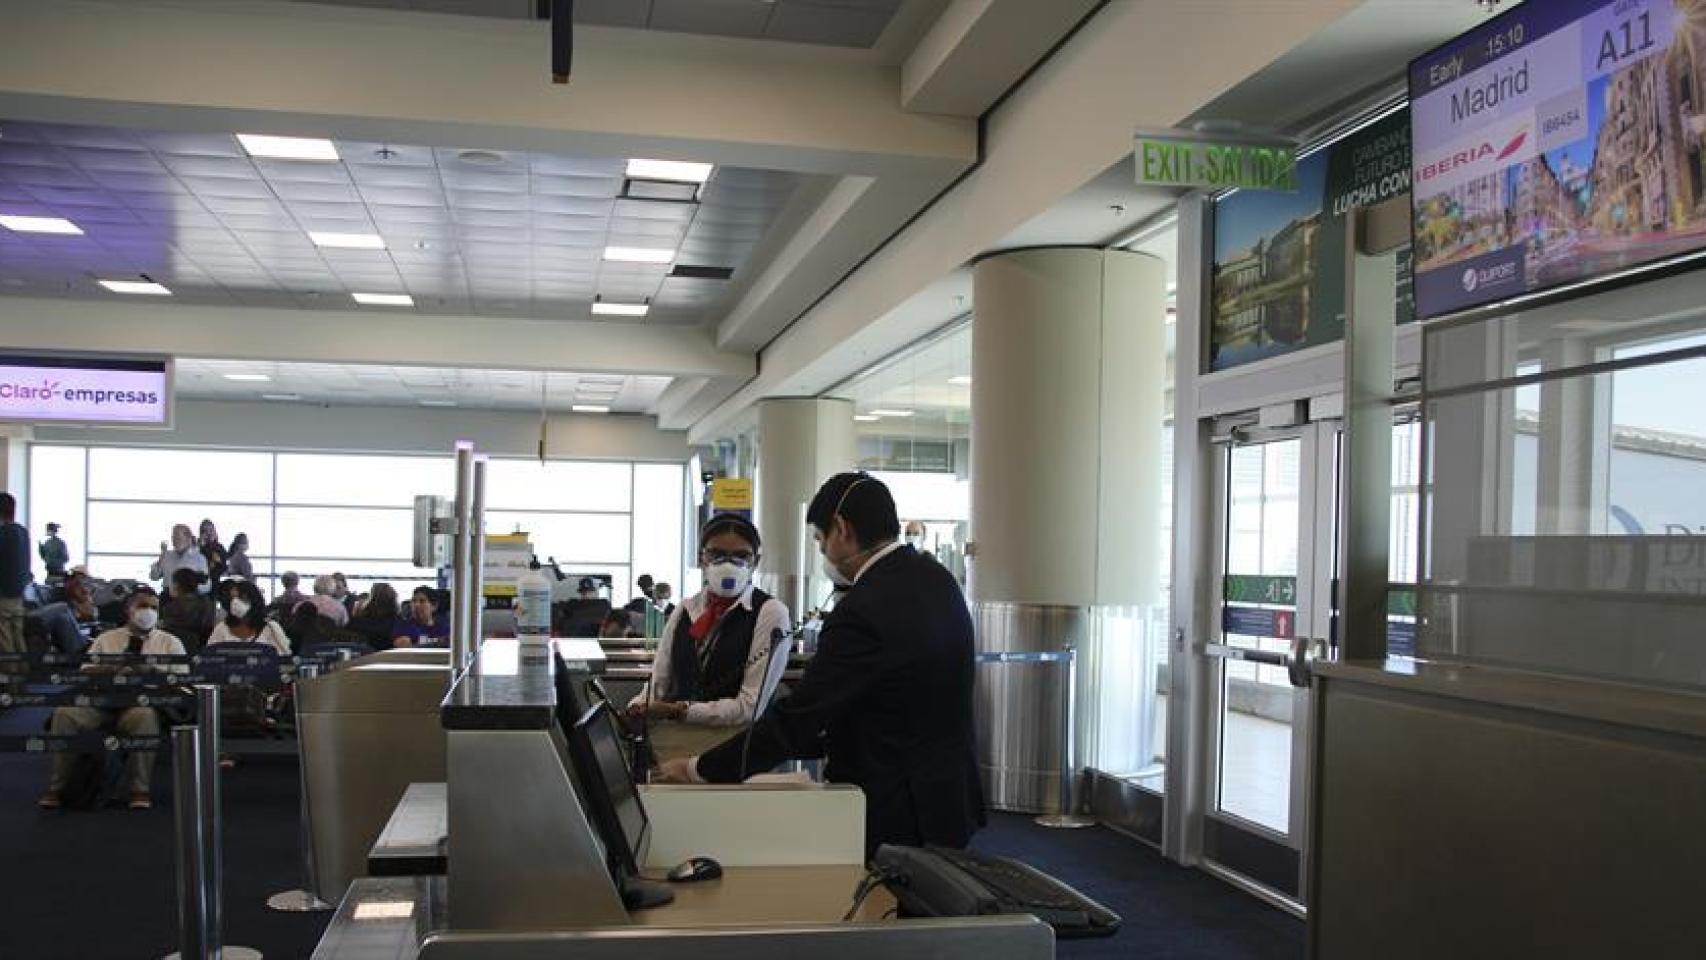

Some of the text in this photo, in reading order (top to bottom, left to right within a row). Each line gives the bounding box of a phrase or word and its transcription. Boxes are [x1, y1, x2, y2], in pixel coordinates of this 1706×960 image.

[1430, 23, 1524, 85] Early 15:10
[1597, 10, 1654, 68] A11
[1451, 60, 1529, 122] Madrid
[1142, 141, 1292, 190] EXIT SALIDA
[1415, 142, 1495, 183] IBERIA
[1333, 182, 1376, 216] LUCHA
[0, 380, 158, 405] Claro empresas
